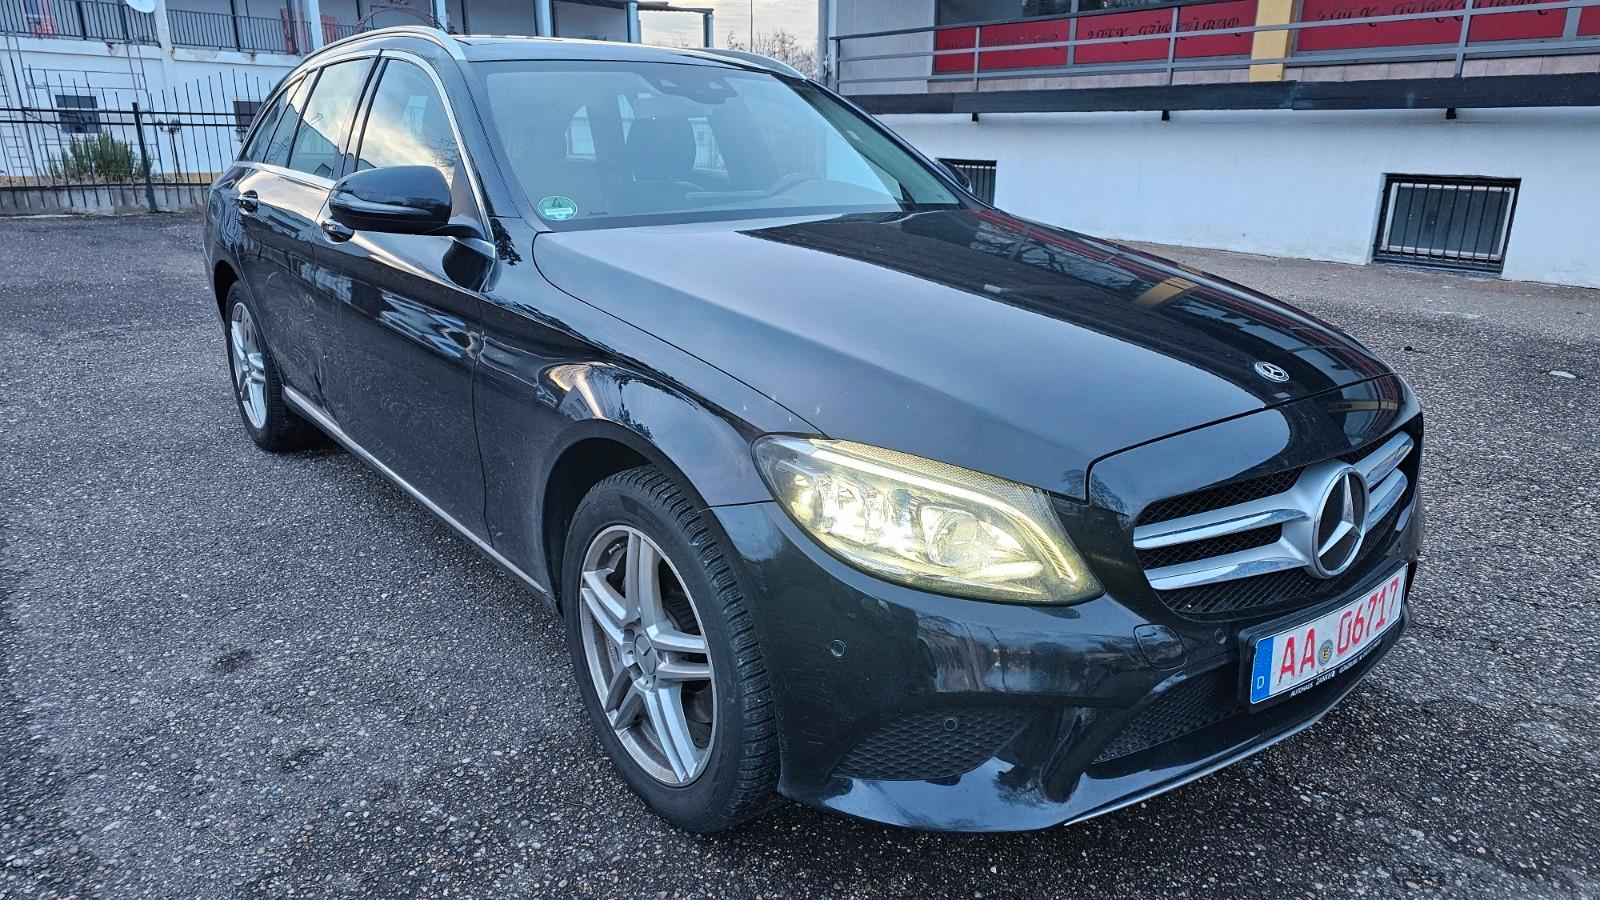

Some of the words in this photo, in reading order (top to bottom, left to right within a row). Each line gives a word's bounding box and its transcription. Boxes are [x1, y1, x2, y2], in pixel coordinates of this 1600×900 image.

[1278, 627, 1316, 684] AA
[1336, 576, 1400, 656] 06717
[1256, 675, 1265, 690] D
